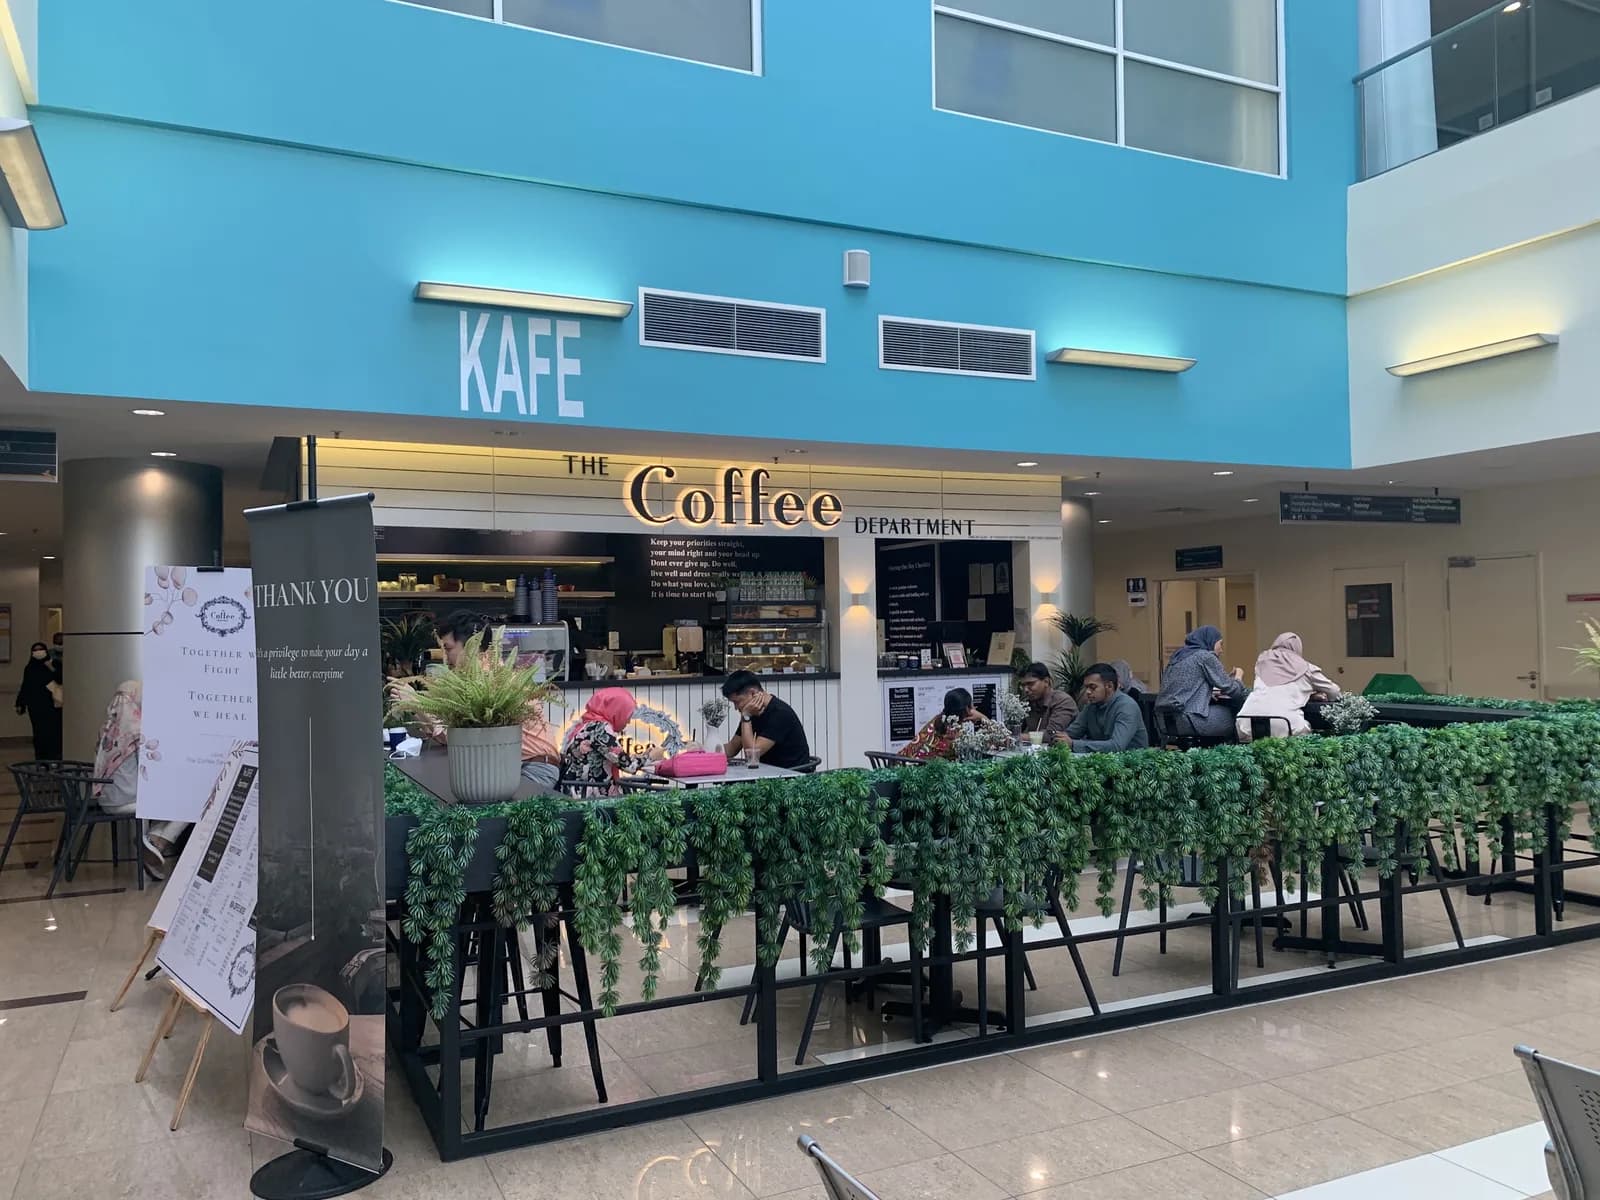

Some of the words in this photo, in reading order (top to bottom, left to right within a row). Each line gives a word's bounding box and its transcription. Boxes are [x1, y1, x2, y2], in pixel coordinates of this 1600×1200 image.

[459, 310, 585, 418] KAFE
[563, 455, 609, 476] THE
[629, 464, 843, 527] Coffee
[855, 516, 976, 538] DEPARTMENT
[650, 538, 668, 547] Keep
[686, 539, 717, 548] priorities
[668, 549, 686, 557] mind
[686, 549, 703, 558] right
[684, 559, 698, 568] give
[650, 580, 662, 588] Do
[680, 581, 693, 589] you
[253, 580, 317, 608] THANK
[320, 577, 369, 604] YOU
[180, 646, 243, 659] TOGETHER
[267, 645, 300, 662] privilege
[301, 647, 309, 658] to
[324, 647, 343, 662] your
[344, 643, 361, 661] day
[361, 648, 369, 658] a
[203, 663, 241, 676] FIGHT
[270, 666, 288, 679] little
[289, 665, 312, 680] better,
[312, 667, 345, 683] everytime
[188, 690, 253, 704] TOGETHER
[192, 710, 210, 720] WE
[215, 711, 248, 722] HEAL
